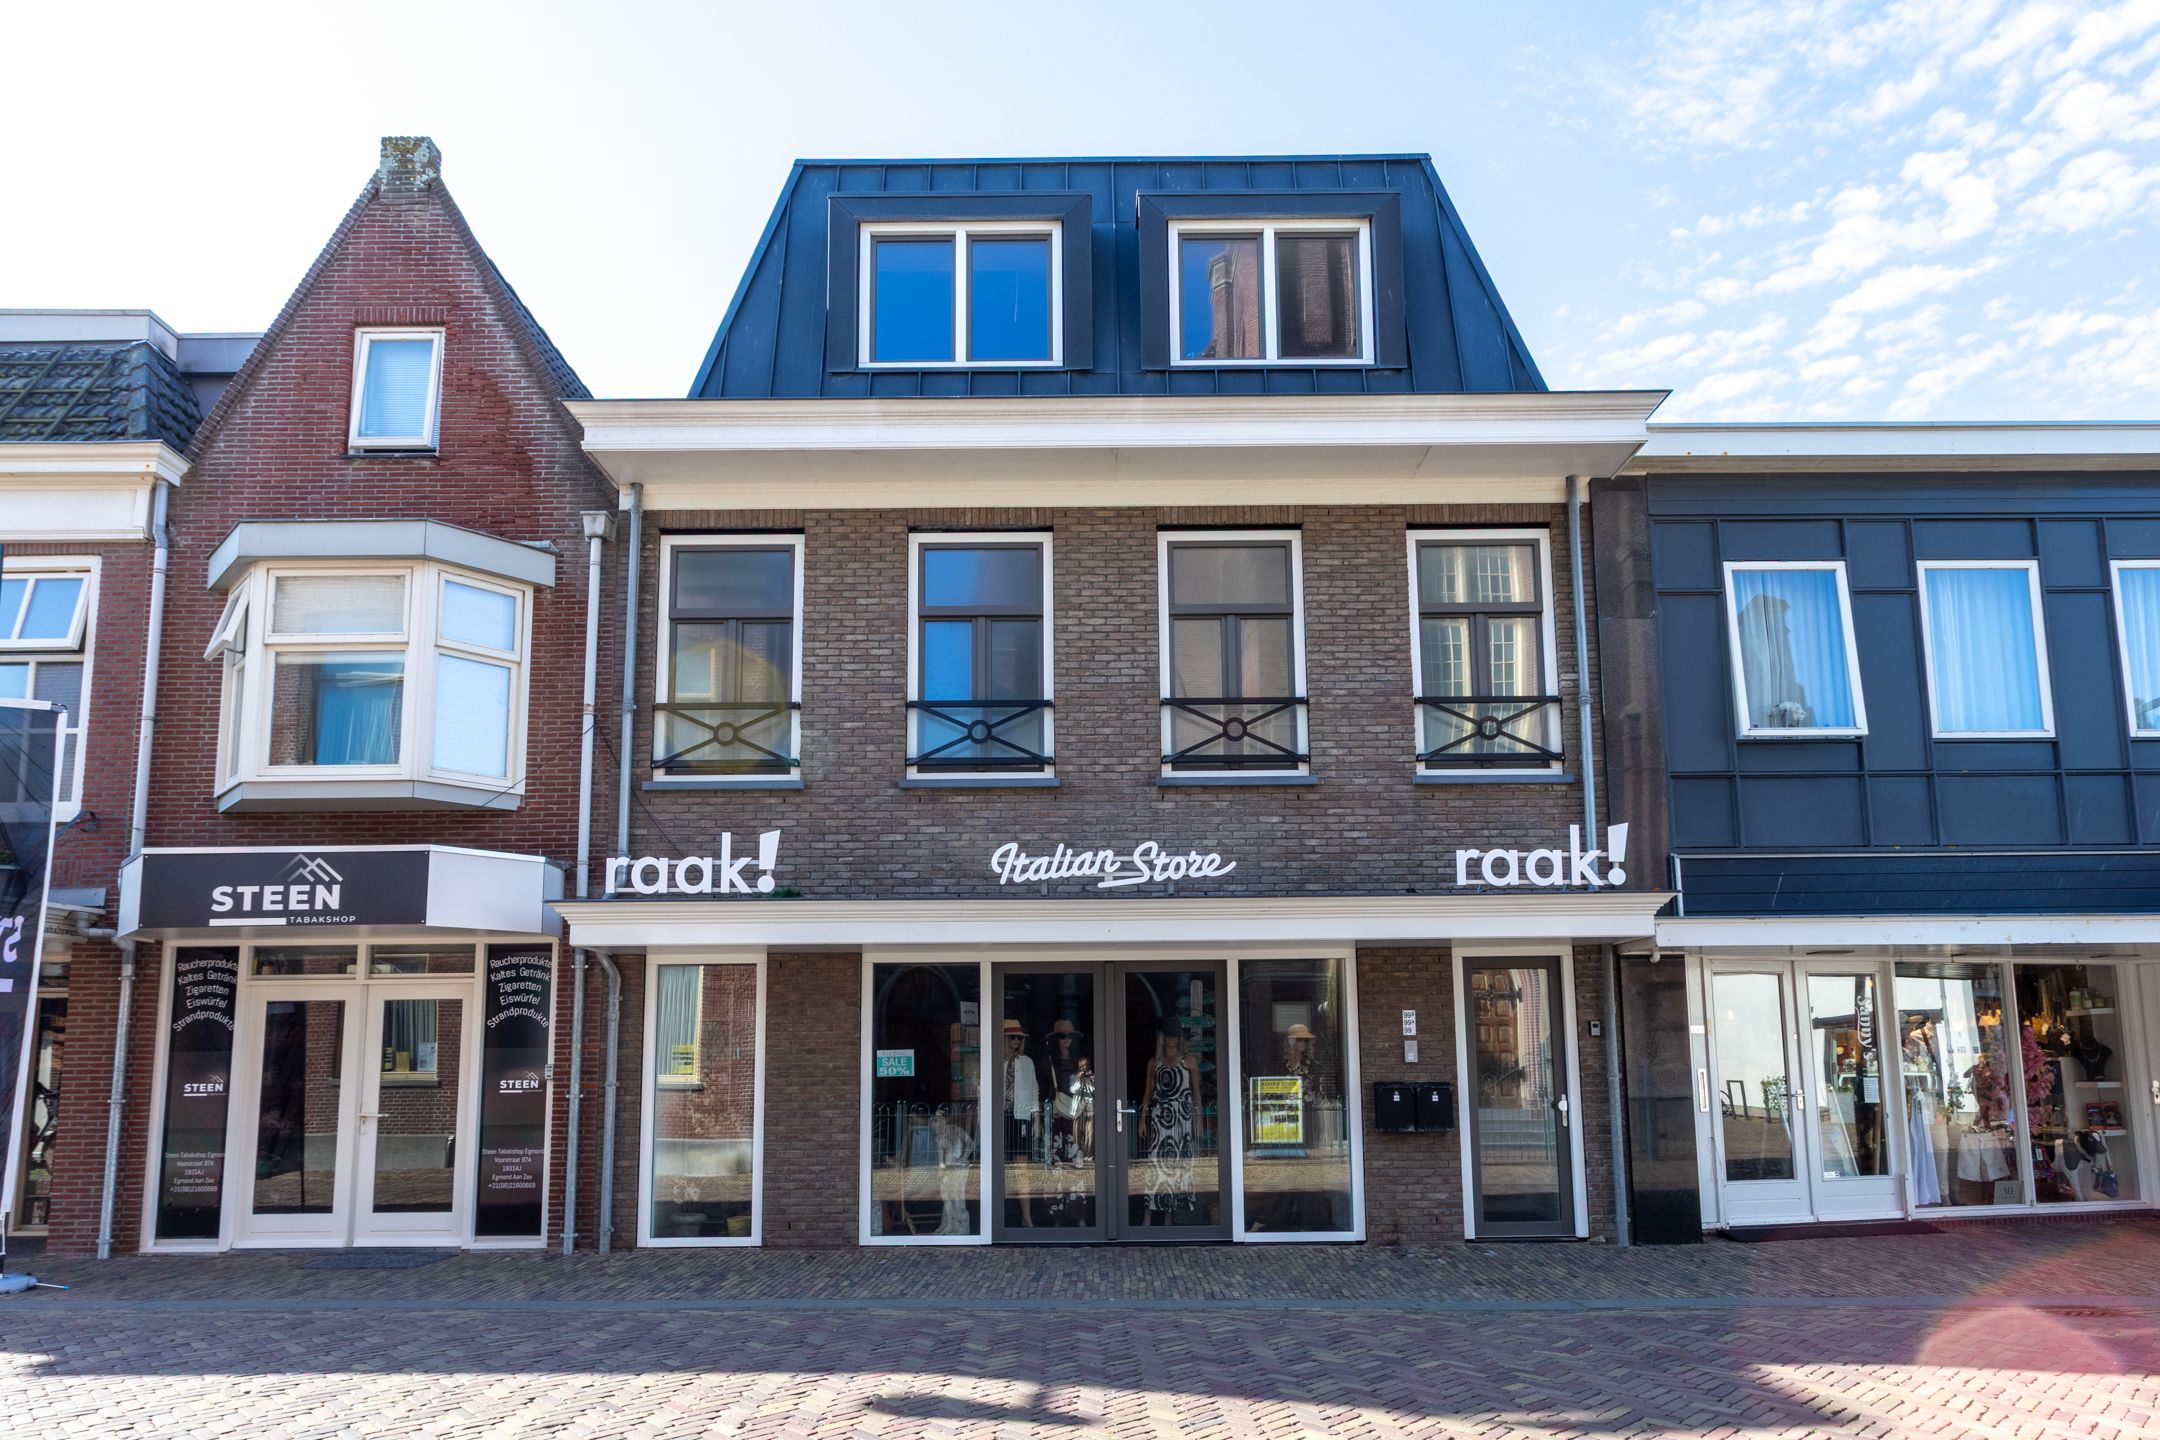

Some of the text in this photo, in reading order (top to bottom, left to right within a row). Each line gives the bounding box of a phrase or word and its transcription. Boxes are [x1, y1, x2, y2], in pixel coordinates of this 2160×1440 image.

[1455, 822, 1629, 886] raak!
[605, 829, 781, 894] raak!
[991, 841, 1237, 888] Italian Store
[210, 884, 341, 912] STEEN
[289, 915, 356, 924] TABAKSHOP
[490, 955, 552, 969] Raucherprodukte
[177, 972, 204, 985] Kaltes
[490, 967, 551, 982] Kaltes Getränk
[185, 985, 229, 996] Zigaretten
[498, 981, 542, 993] Zigaretten
[186, 996, 228, 1009] Eiswürfel
[499, 993, 541, 1006] Eiswürfel
[487, 1007, 549, 1028] Strandprodukte
[882, 1058, 907, 1066] SALE
[880, 1067, 910, 1075] 50%
[184, 1083, 224, 1092] STEEN
[500, 1080, 539, 1089] STEEN
